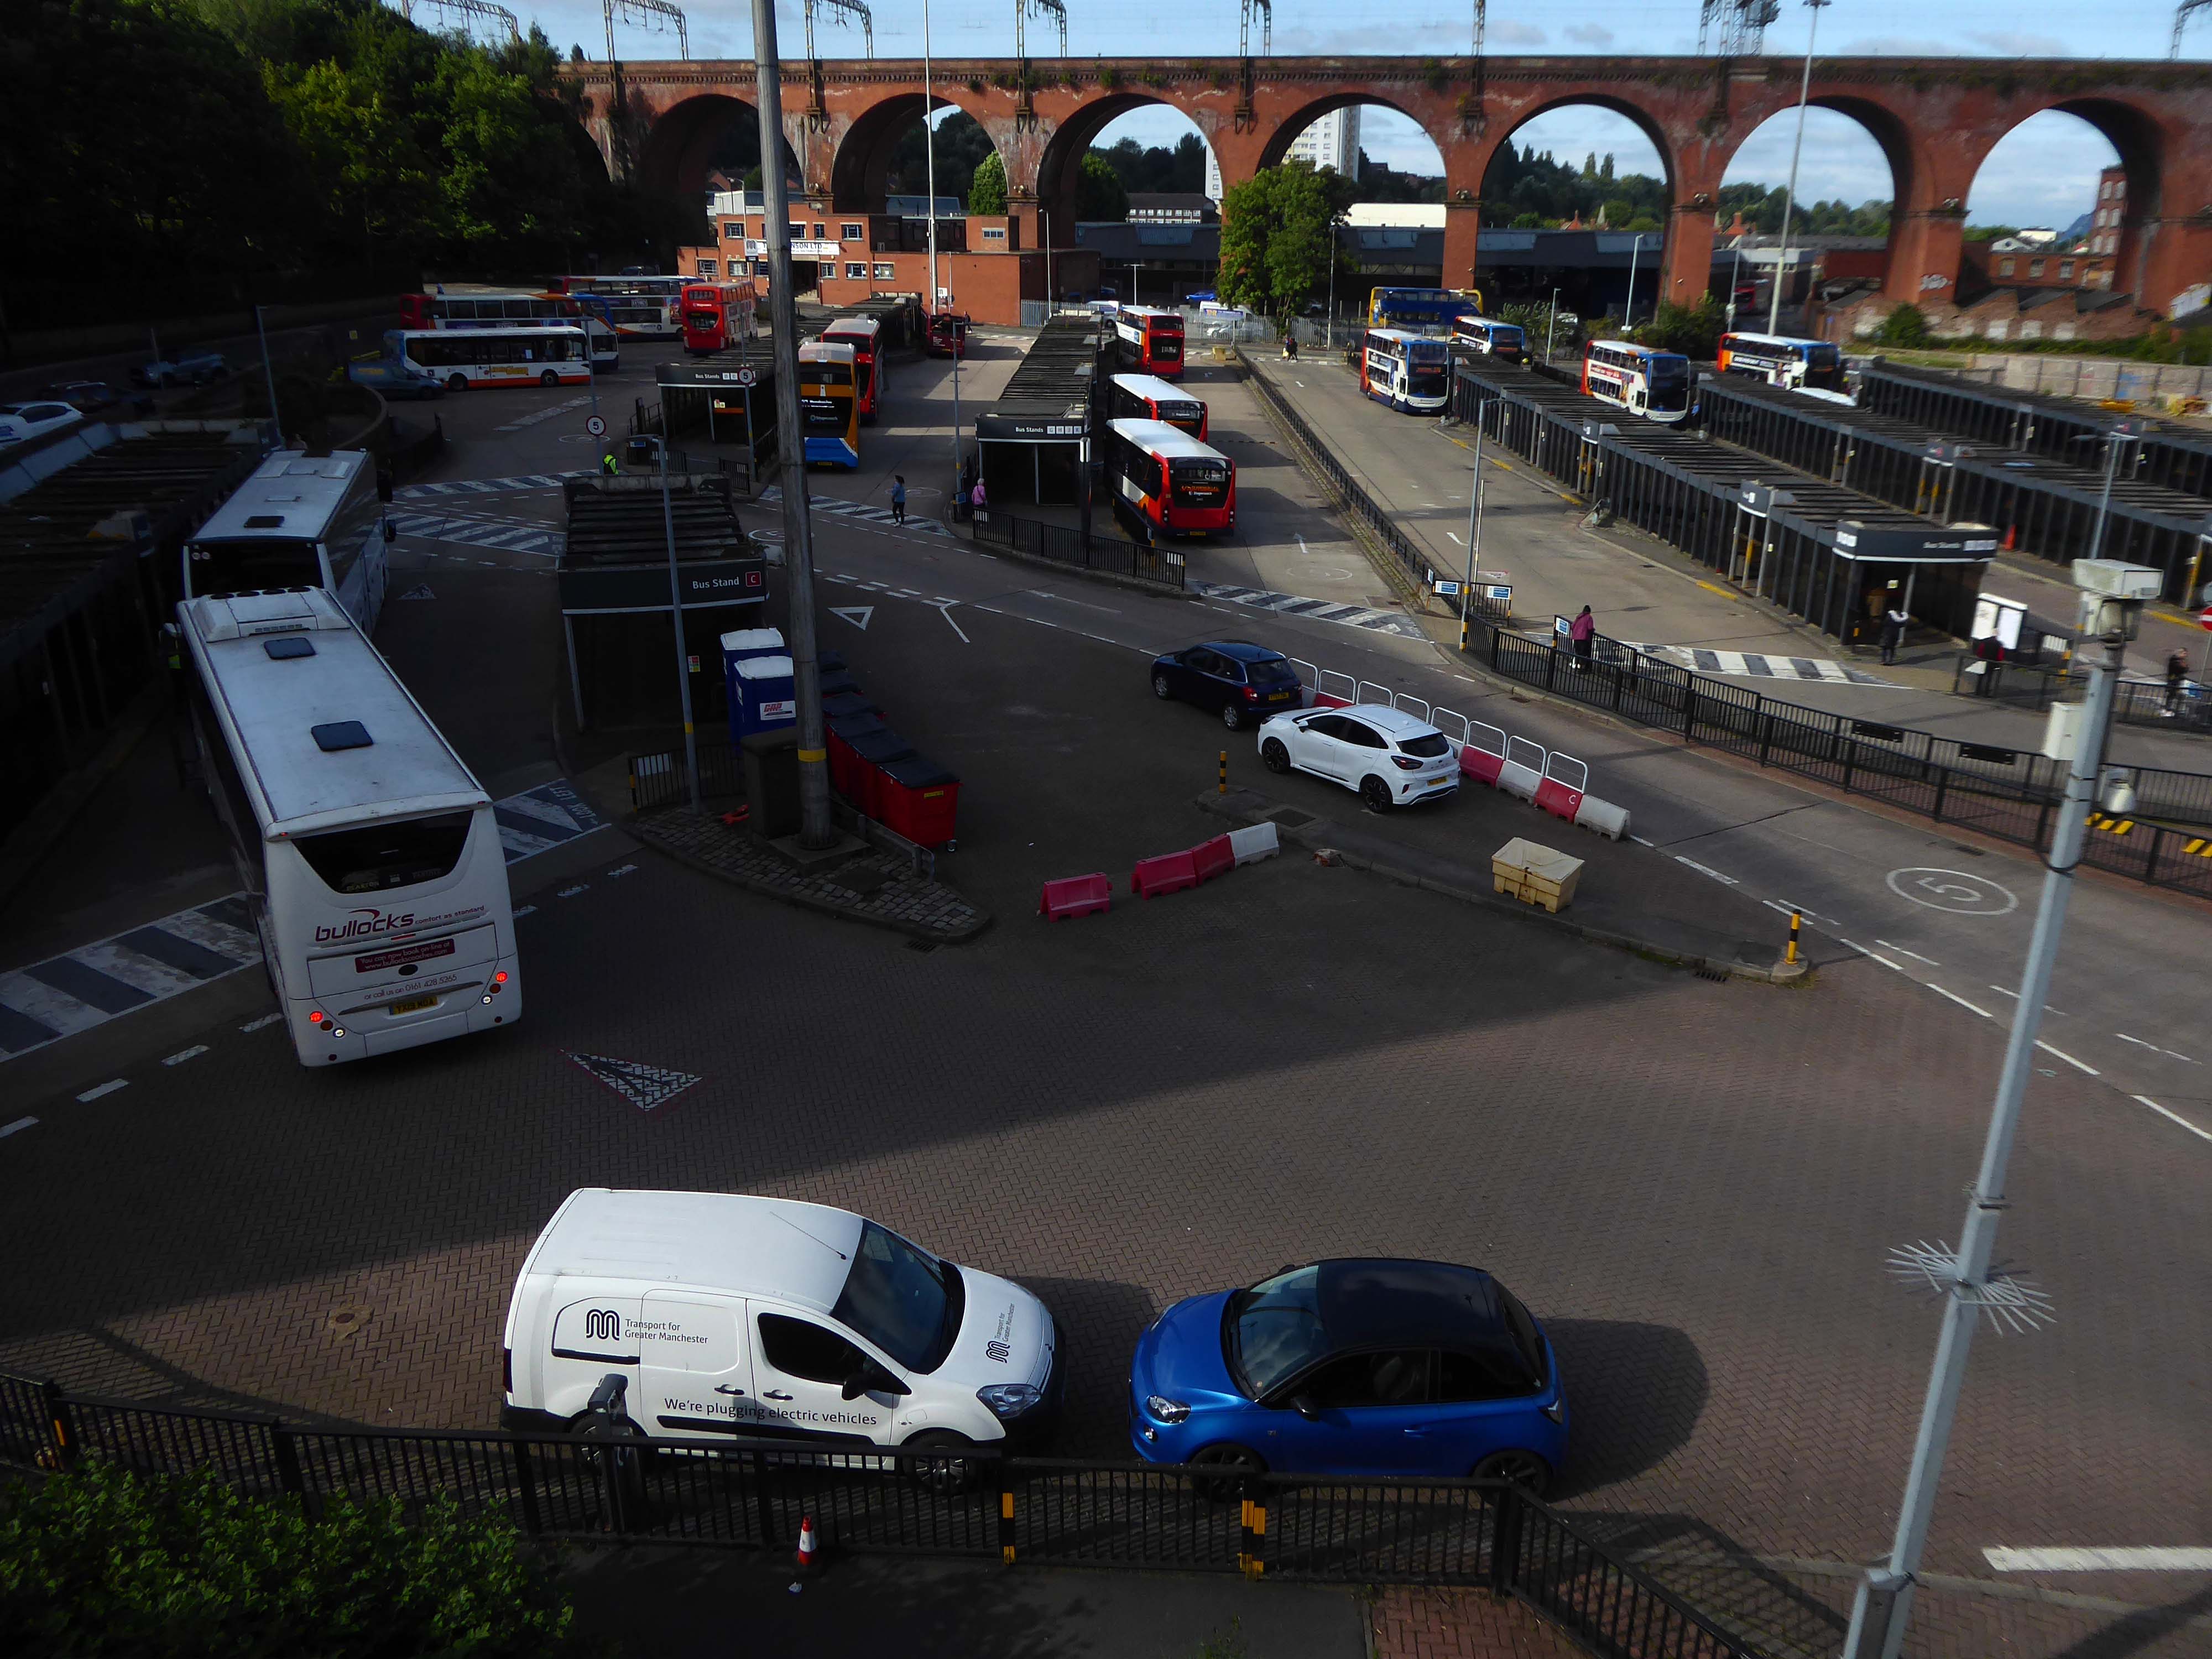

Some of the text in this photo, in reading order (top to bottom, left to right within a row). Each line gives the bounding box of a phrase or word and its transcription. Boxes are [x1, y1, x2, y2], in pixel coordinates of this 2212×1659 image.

[593, 421, 599, 430] 5
[692, 575, 757, 589] Bus Stand C
[1916, 877, 1984, 902] 5
[415, 915, 441, 925] comfort
[455, 905, 484, 917] standard
[315, 912, 415, 942] bullocks
[388, 952, 402, 961] now
[403, 947, 420, 957] book
[373, 989, 385, 998] call
[405, 982, 421, 992] 0161
[424, 978, 438, 988] 428
[625, 1318, 681, 1331] Transport for
[994, 1318, 1004, 1339] Transport
[1002, 1302, 1015, 1342] Greater Manchester
[624, 1329, 708, 1344] Greater Manchester
[664, 1397, 877, 1425] We're plugging electric vehicles
